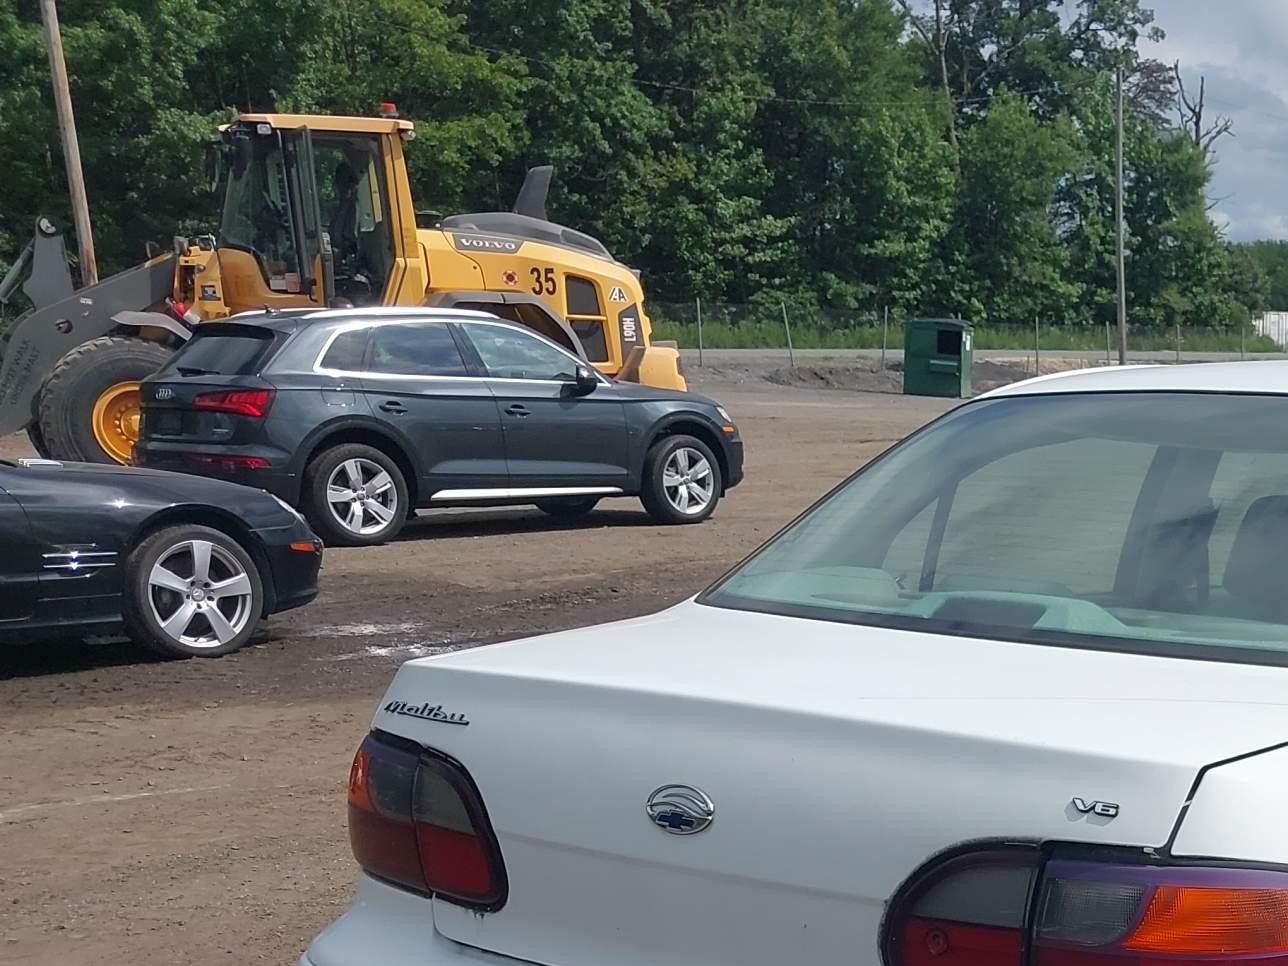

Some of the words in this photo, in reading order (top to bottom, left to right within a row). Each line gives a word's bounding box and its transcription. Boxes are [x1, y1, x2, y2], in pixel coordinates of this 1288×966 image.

[459, 238, 516, 250] VOLVO
[530, 267, 557, 295] 35
[621, 317, 637, 342] L90H
[384, 701, 470, 726] Malibu
[1072, 797, 1120, 818] V6
